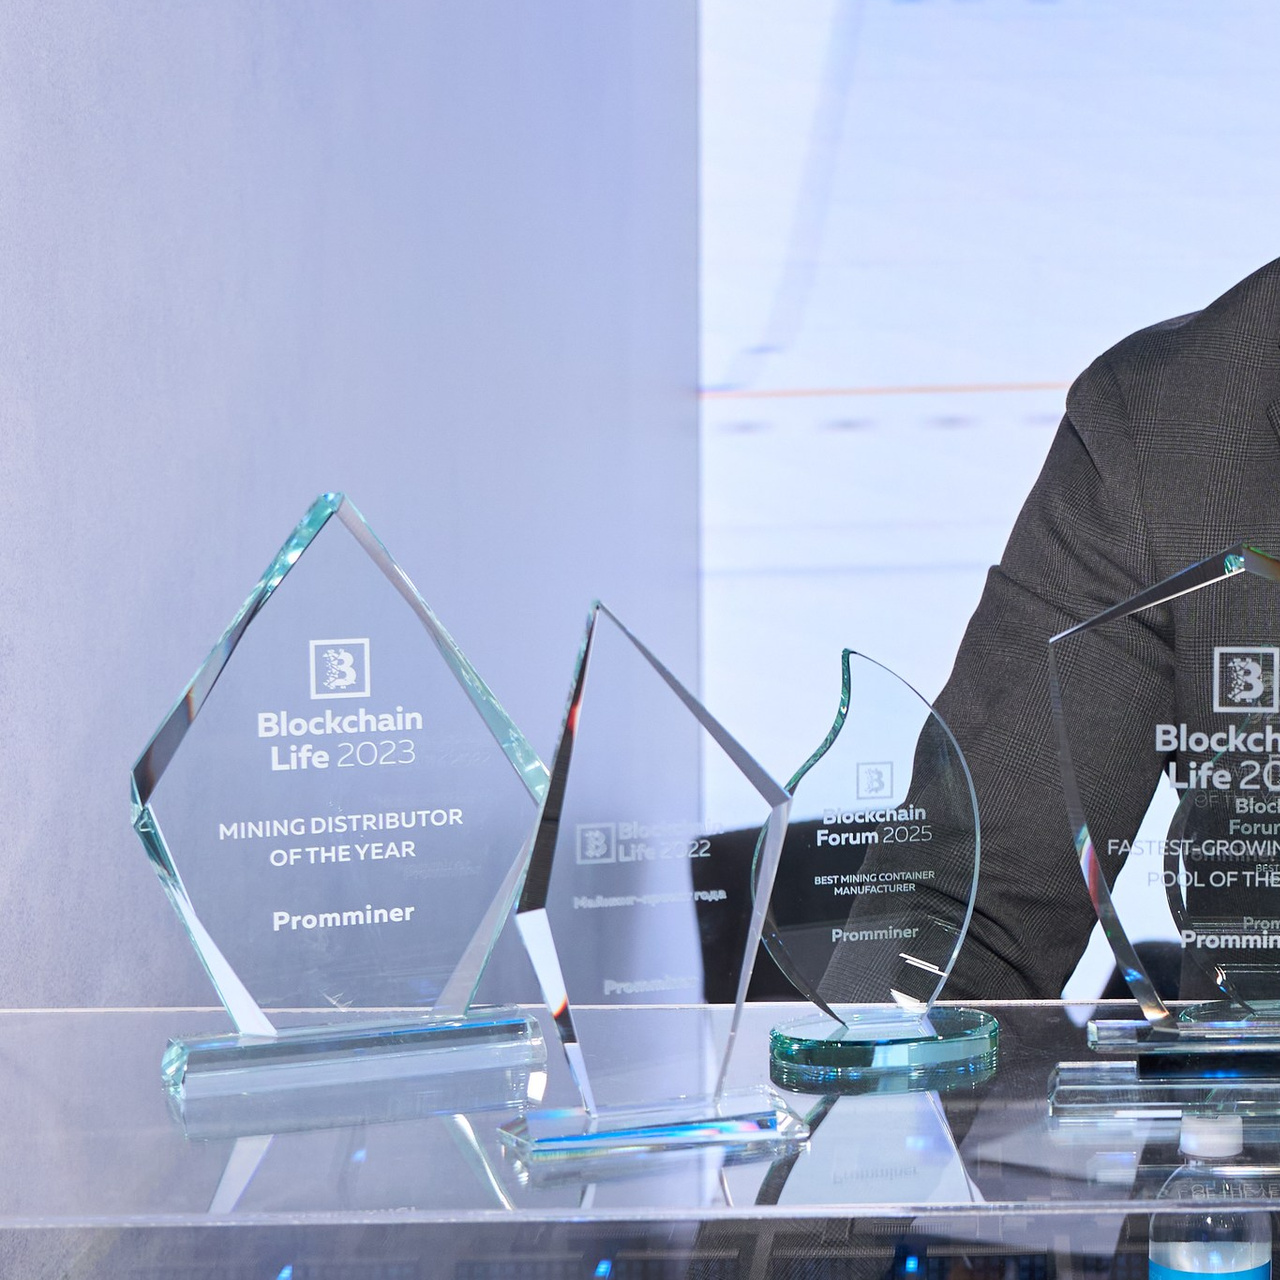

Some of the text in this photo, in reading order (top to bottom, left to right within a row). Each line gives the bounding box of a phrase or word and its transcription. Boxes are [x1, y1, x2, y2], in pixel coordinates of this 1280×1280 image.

[258, 705, 423, 738] Blockchain
[271, 739, 416, 771] Life 2023
[1168, 761, 1232, 790] Life
[218, 808, 464, 841] MINING DISTRIBUTOR
[823, 804, 926, 825] Blockchain
[816, 825, 933, 847] Forum 2025
[270, 841, 416, 867] OF THE YEAR
[618, 839, 712, 863] Life 2022
[814, 870, 935, 885] BEST MINING CONTAINER
[834, 883, 916, 896] MANUFACTURER
[1147, 871, 1206, 888] POOL
[1209, 871, 1239, 888] OF
[273, 904, 415, 931] Promminer
[831, 926, 919, 943] Promminer
